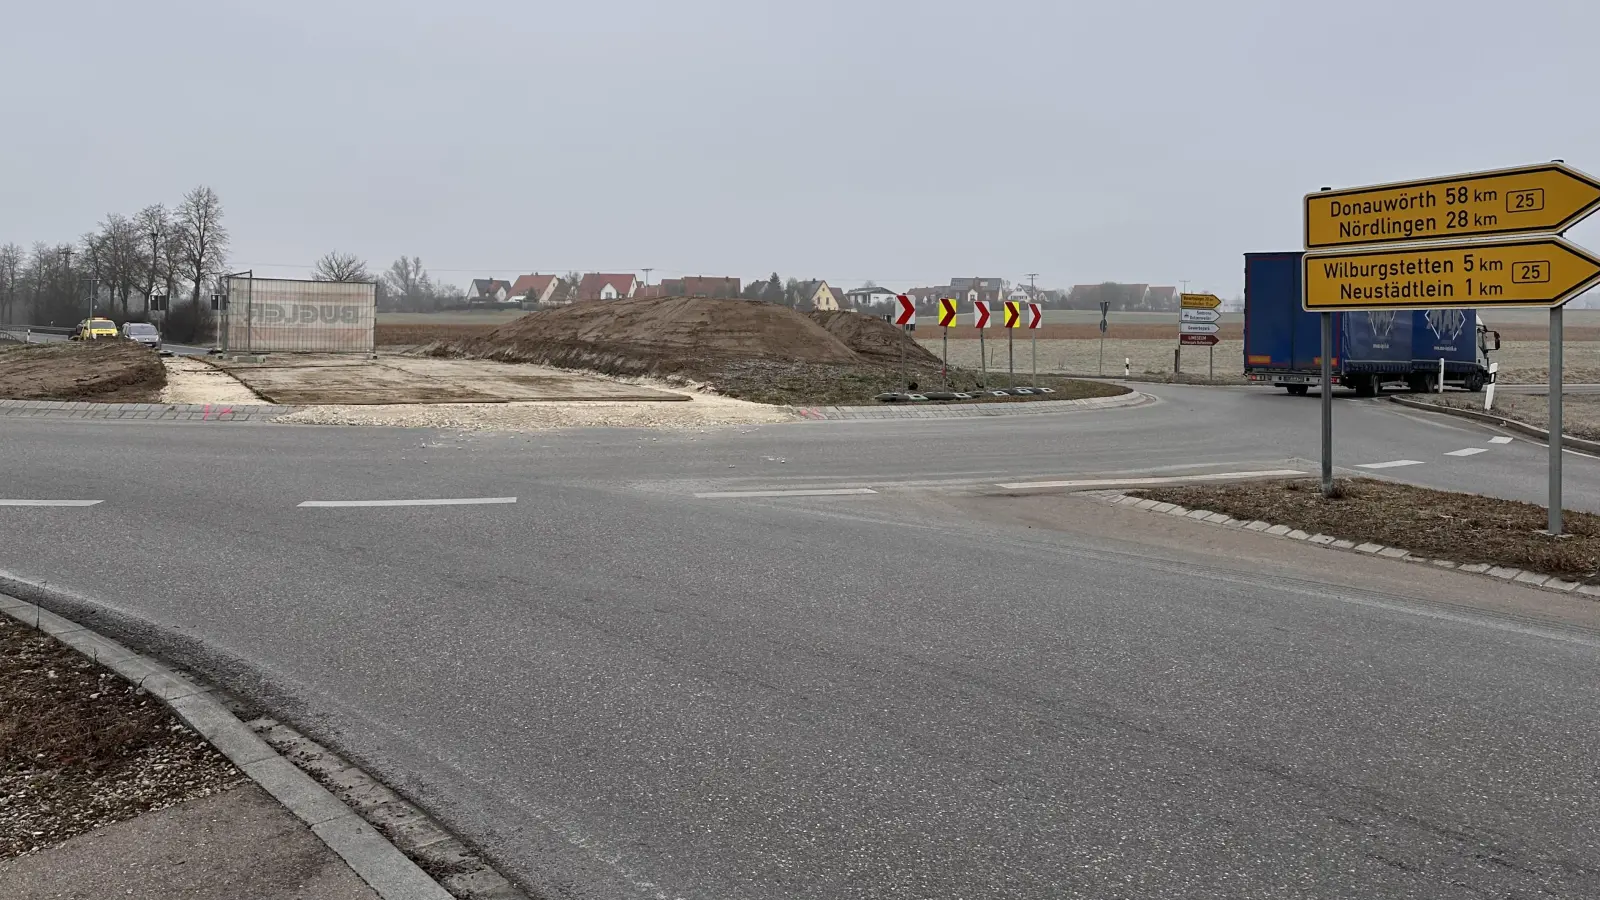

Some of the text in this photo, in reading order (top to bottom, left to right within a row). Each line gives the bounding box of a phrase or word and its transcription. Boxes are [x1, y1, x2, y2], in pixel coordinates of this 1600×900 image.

[1330, 186, 1497, 217] Donauwörth 58 km
[1516, 193, 1534, 209] 25
[1339, 210, 1497, 237] Nördlingen 28 km
[1324, 254, 1503, 280] Wilburgstetten 5 km
[1521, 265, 1540, 280] 25
[1340, 279, 1503, 299] Neustädtlein 1 km
